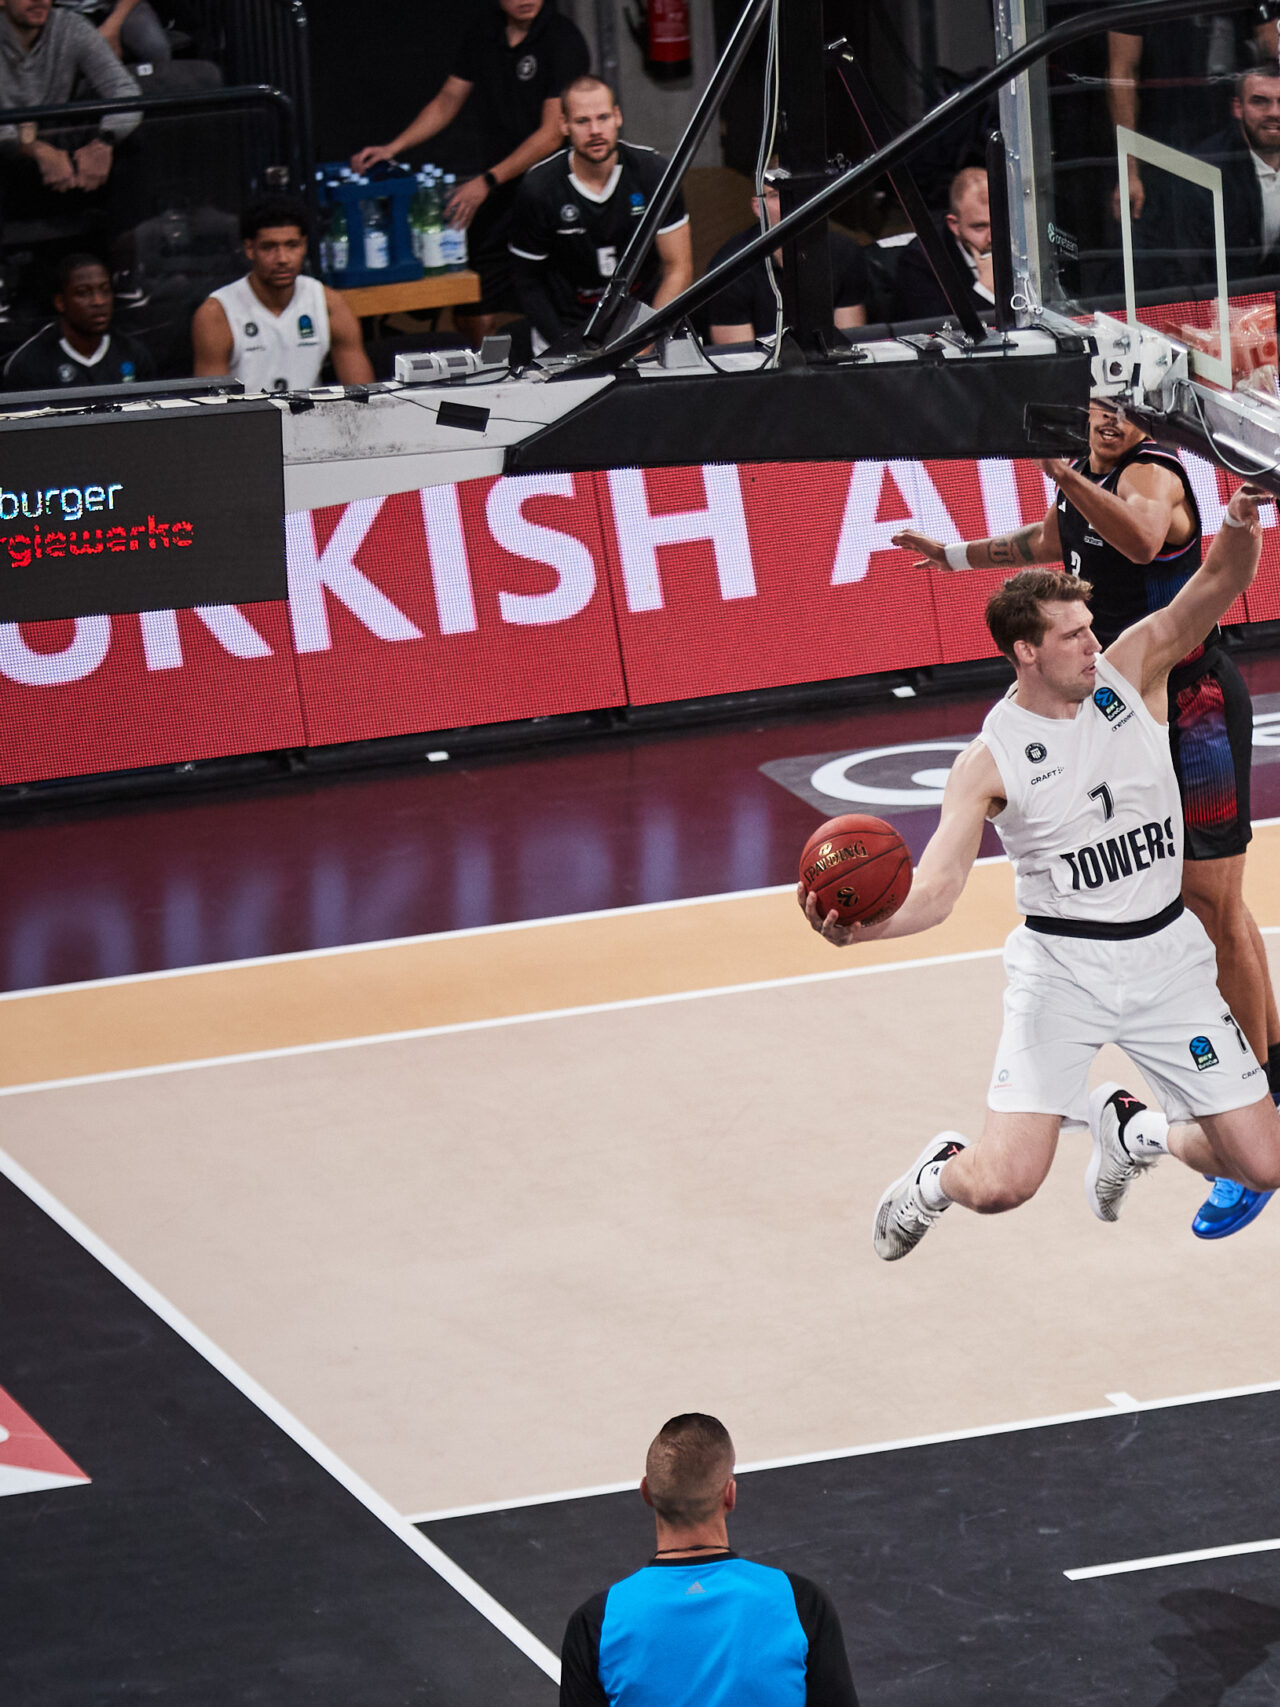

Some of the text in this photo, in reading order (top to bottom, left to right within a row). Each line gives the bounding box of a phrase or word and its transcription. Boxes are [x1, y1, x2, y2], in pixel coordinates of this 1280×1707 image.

[0, 483, 123, 521] burger
[1030, 769, 1057, 786] CRAFT
[1087, 781, 1115, 824] 7
[1220, 1011, 1249, 1055] 7
